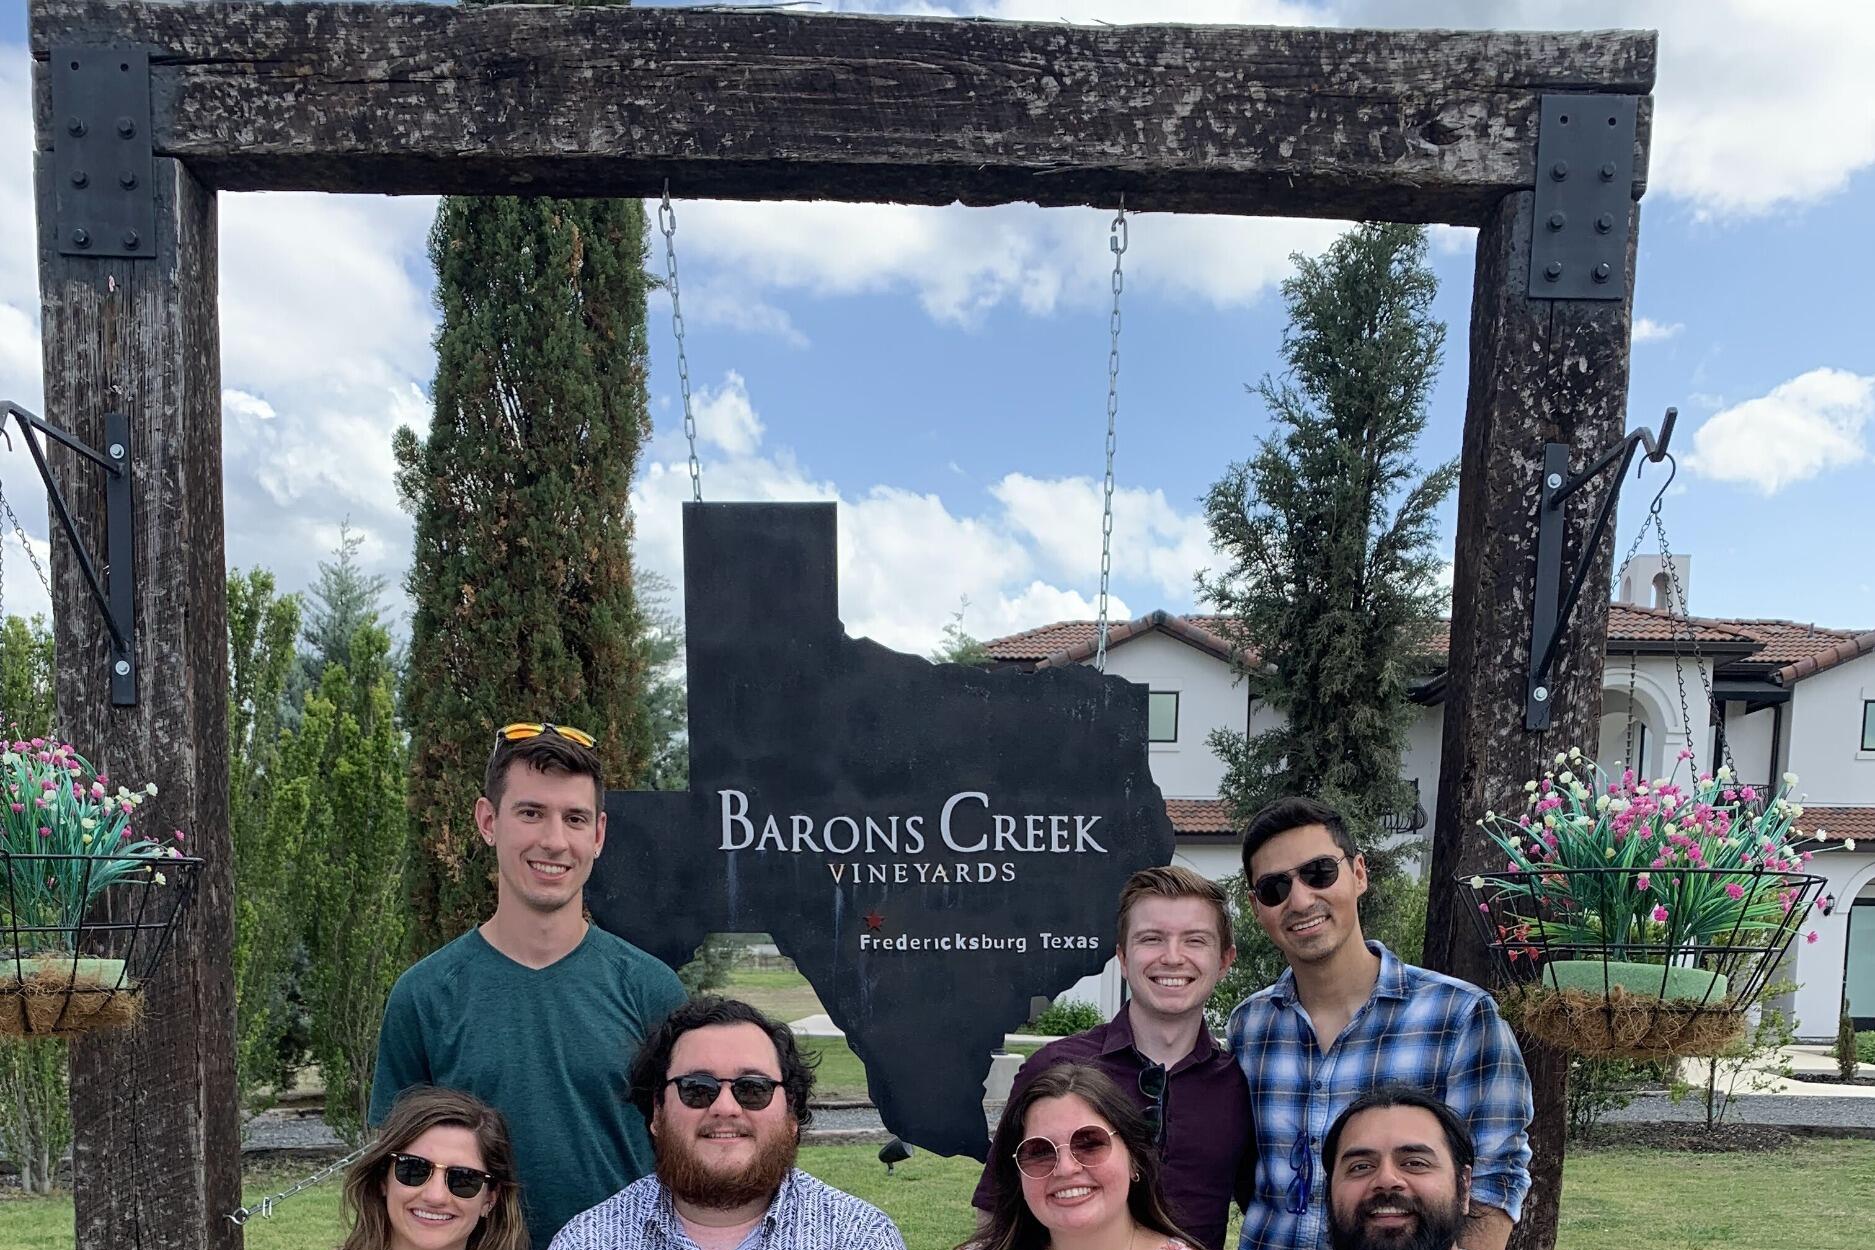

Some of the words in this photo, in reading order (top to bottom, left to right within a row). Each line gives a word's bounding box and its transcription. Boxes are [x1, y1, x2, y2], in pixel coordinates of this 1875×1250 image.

[717, 789, 926, 855] BARONS
[940, 791, 1108, 854] CREEK
[827, 862, 1017, 884] VINEYARDS
[860, 932, 1027, 953] Fredericksburg
[1039, 932, 1100, 950] Texas
